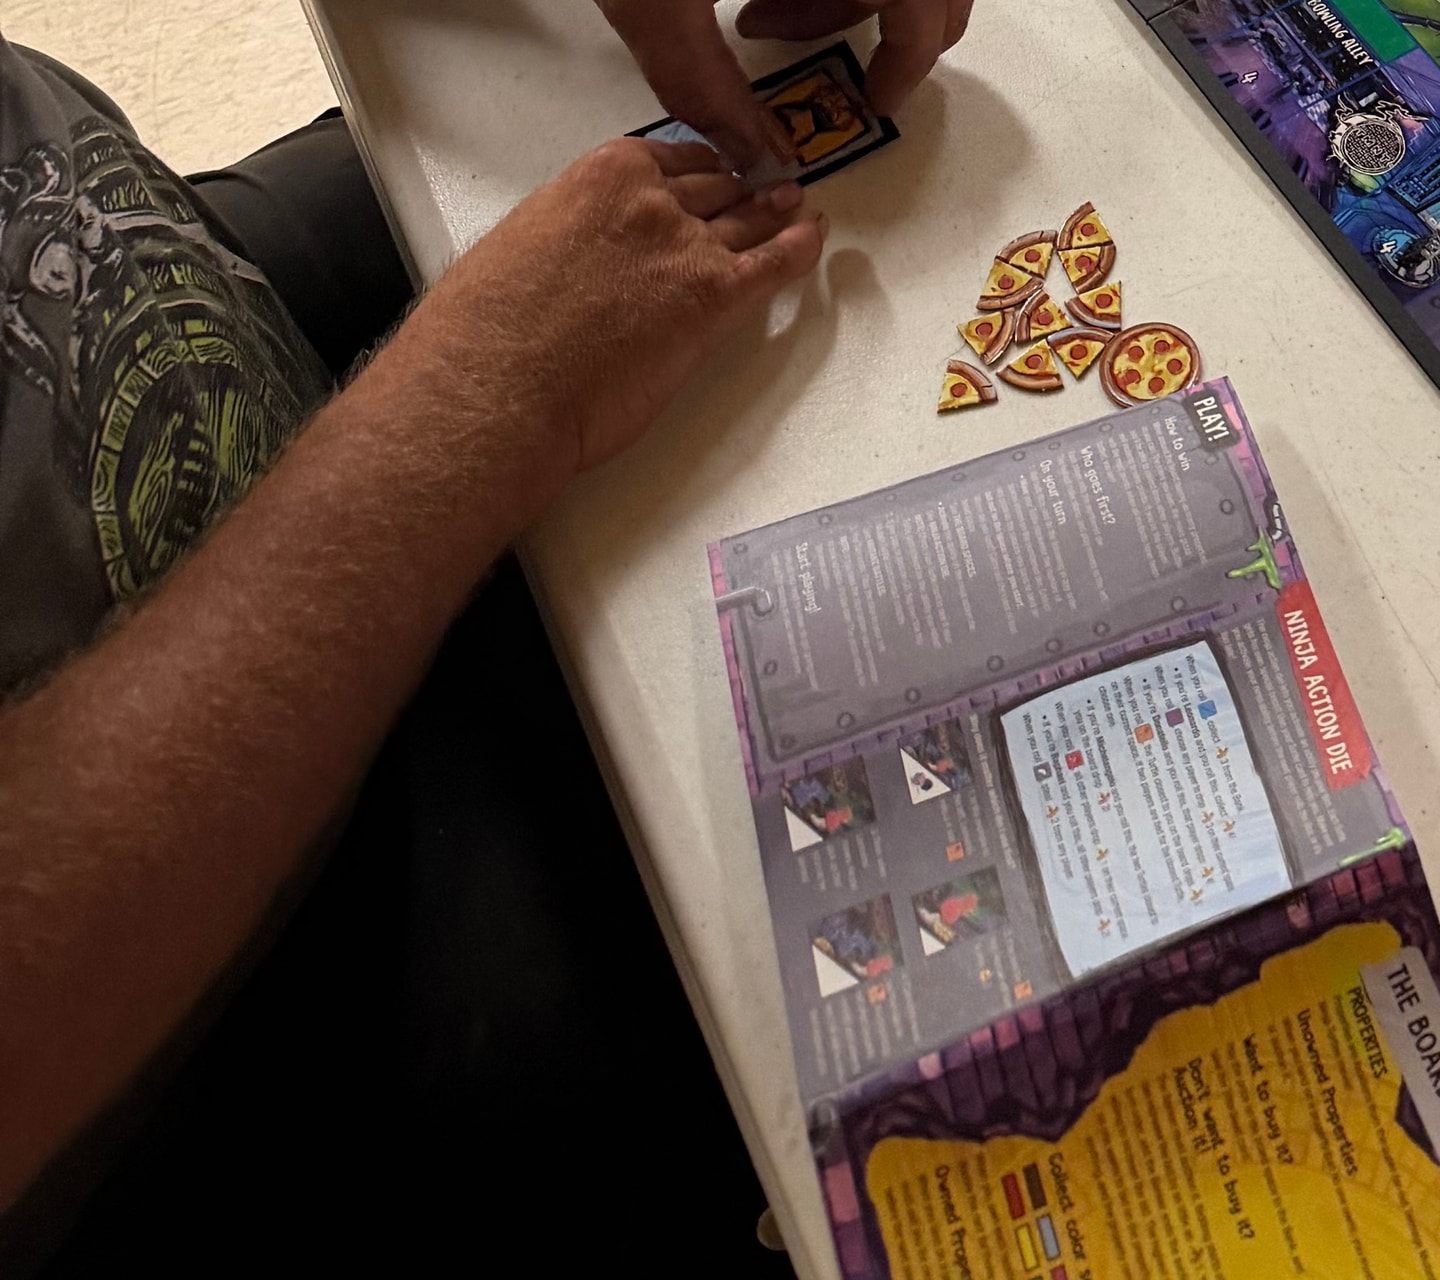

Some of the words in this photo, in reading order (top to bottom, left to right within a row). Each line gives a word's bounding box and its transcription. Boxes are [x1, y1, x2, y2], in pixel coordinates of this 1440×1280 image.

[1340, 33, 1376, 70] ALLEY
[1243, 70, 1258, 87] 4
[1380, 237, 1395, 256] 4
[1163, 415, 1181, 437] How
[1191, 392, 1230, 445] PLAY!
[1078, 444, 1097, 468] Who
[1170, 436, 1185, 451] to
[1174, 450, 1192, 472] win
[1038, 458, 1055, 477] On
[1084, 467, 1103, 495] goes
[1041, 477, 1060, 500] your
[1051, 500, 1069, 526] turn
[1095, 494, 1117, 527] first?
[792, 540, 814, 570] Start
[795, 569, 824, 616] playing!
[1283, 608, 1319, 670] NINJA
[1302, 671, 1342, 741] ACTION
[1324, 740, 1353, 775] DIE
[1182, 701, 1203, 739] Leonardo
[1385, 964, 1421, 1013] THE
[1350, 985, 1390, 1080] PROPERTIES
[1239, 1033, 1265, 1077] Want
[1188, 1057, 1217, 1103] Don't
[1253, 1079, 1274, 1103] to
[1295, 1008, 1330, 1085] Unowned
[1320, 1086, 1359, 1177] Properties
[1168, 1066, 1200, 1131] Auction
[1190, 1131, 1214, 1156] it!
[1198, 1107, 1228, 1148] want
[1260, 1104, 1285, 1142] buy
[1213, 1154, 1234, 1177] to
[1274, 1141, 1297, 1167] it?
[933, 1164, 962, 1226] Owned
[1046, 1152, 1078, 1215] Collect
[1062, 1219, 1089, 1263] color
[1217, 1178, 1249, 1215] buy
[1233, 1216, 1256, 1243] it?
